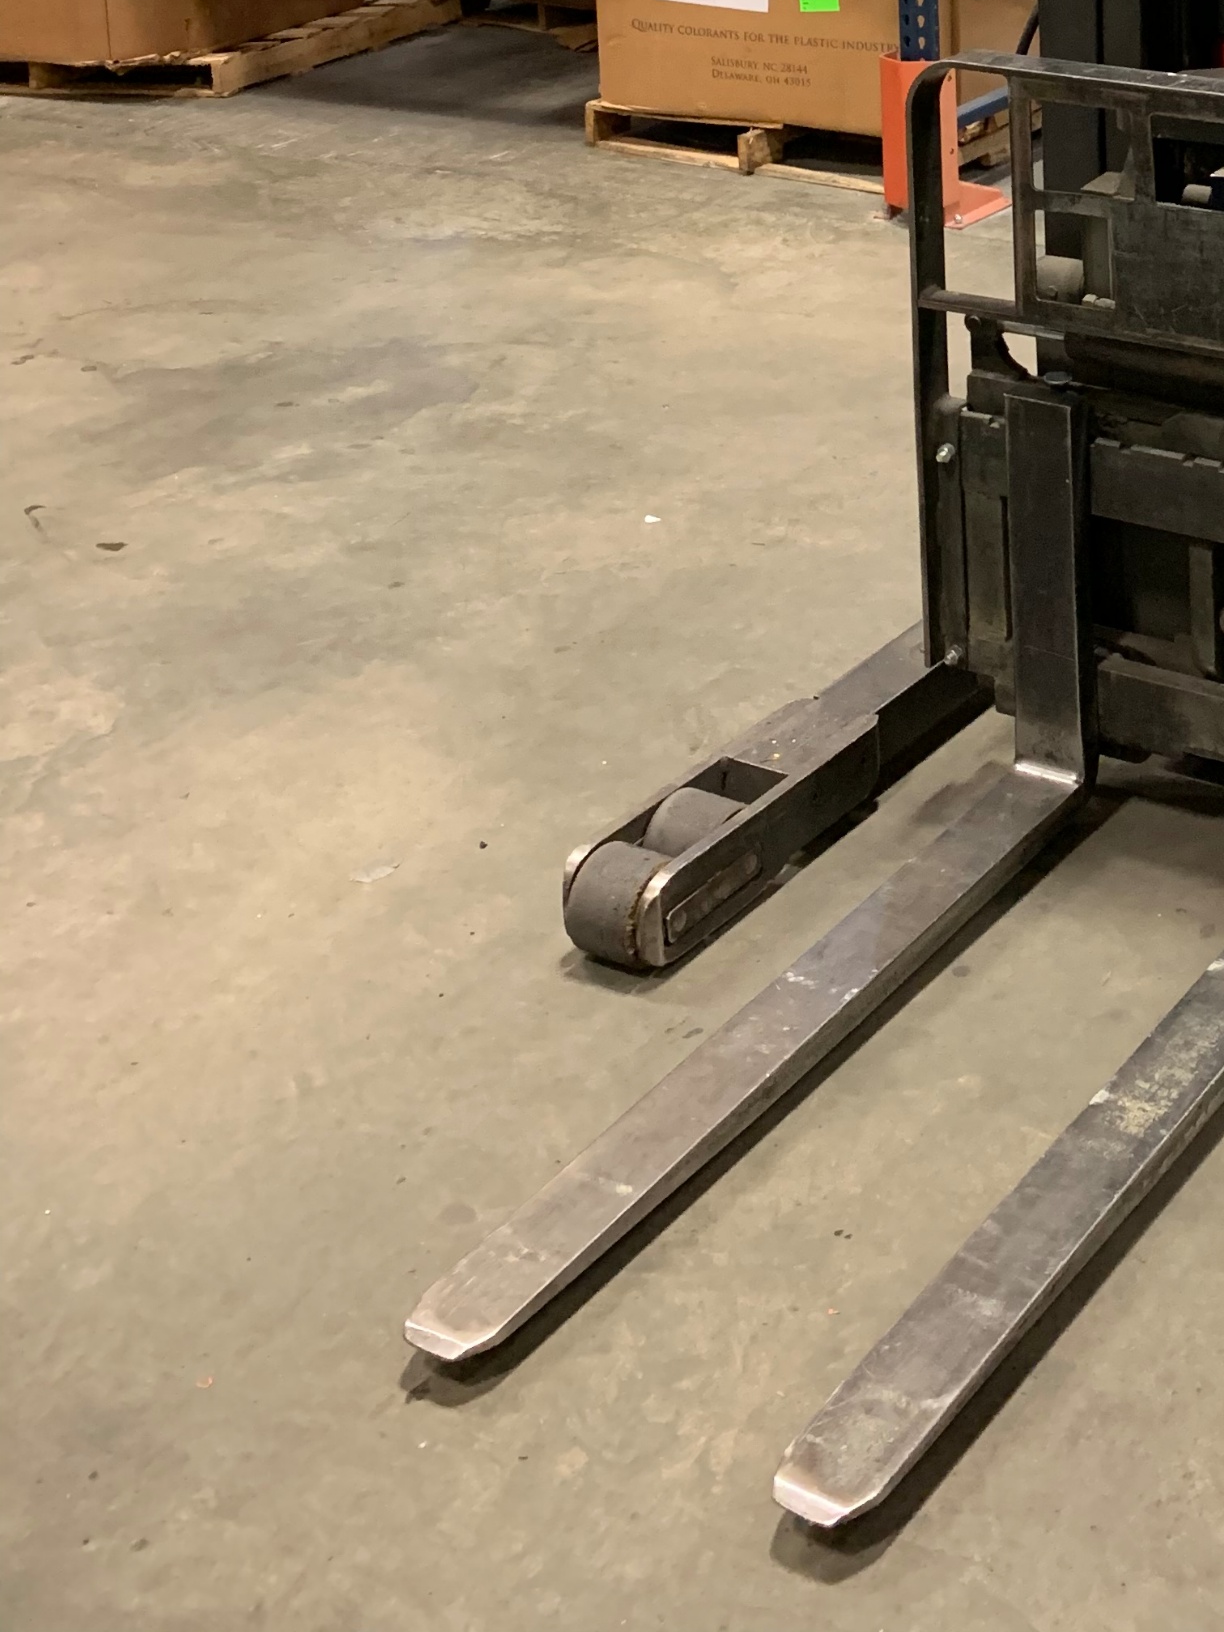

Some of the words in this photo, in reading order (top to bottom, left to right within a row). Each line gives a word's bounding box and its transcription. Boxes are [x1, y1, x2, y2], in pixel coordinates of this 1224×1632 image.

[631, 18, 675, 34] QUALITY
[677, 24, 740, 41] COLORANTS
[743, 31, 765, 42] FOR
[768, 34, 789, 45] THE
[794, 36, 838, 49] PLASTIC
[763, 62, 778, 72] NC
[780, 63, 808, 74] 28144
[766, 76, 780, 85] OH
[784, 77, 811, 87] 43015
